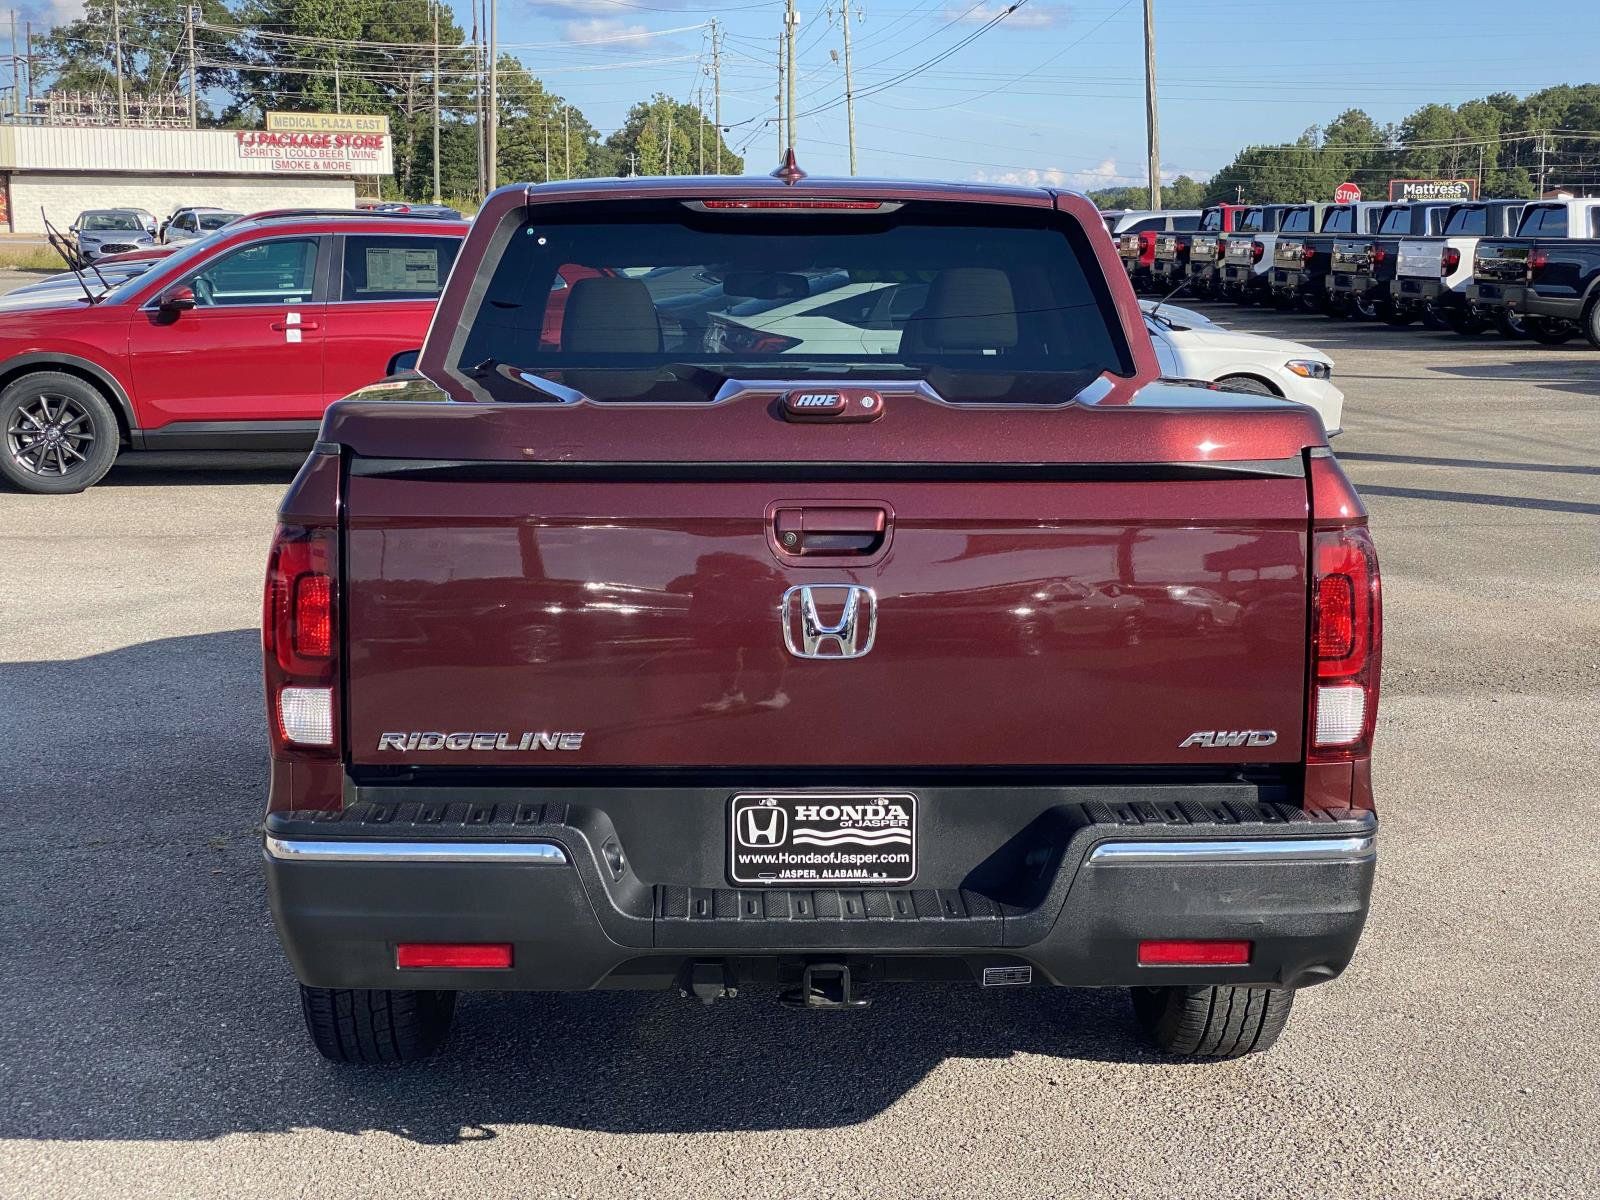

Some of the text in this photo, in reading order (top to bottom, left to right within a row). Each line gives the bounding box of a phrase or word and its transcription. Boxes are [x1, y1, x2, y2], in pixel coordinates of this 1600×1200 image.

[274, 116, 381, 130] MEDICAL PLAZA EAST
[258, 131, 332, 149] PACKAGE
[333, 133, 385, 150] STORE
[243, 148, 377, 159] SPIRITS COLD BEER WINE
[275, 160, 351, 170] SMOKE & MORE
[1336, 189, 1360, 200] STOP
[1403, 183, 1462, 195] Mattress
[795, 394, 840, 407] ARE
[377, 732, 585, 752] RIDGELINE
[1178, 730, 1278, 748] AWD
[794, 805, 910, 821] HONDA
[839, 820, 853, 828] of
[738, 852, 910, 866] www.HondaofJasper.com
[779, 869, 868, 879] JASPER, ALABAMA
